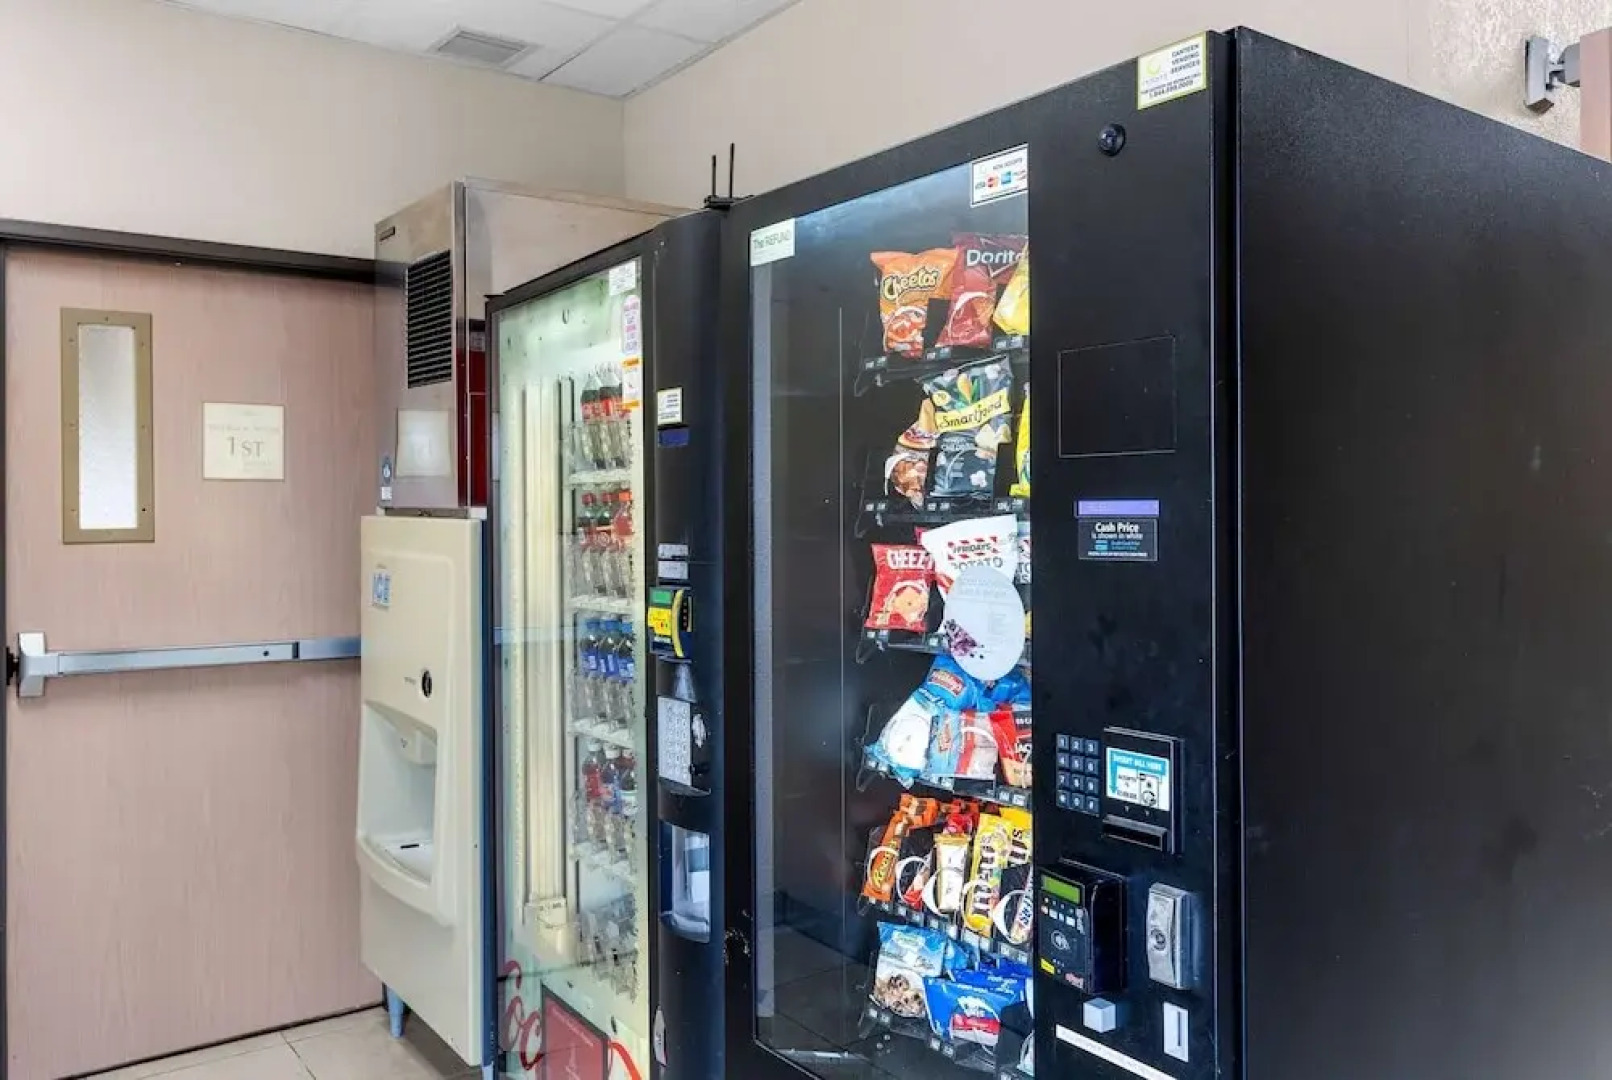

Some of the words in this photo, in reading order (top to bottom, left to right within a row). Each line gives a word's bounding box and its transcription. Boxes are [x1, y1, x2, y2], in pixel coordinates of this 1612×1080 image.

[883, 267, 939, 301] Cheetos
[1095, 522, 1116, 533] Cash
[1117, 522, 1140, 533] Price
